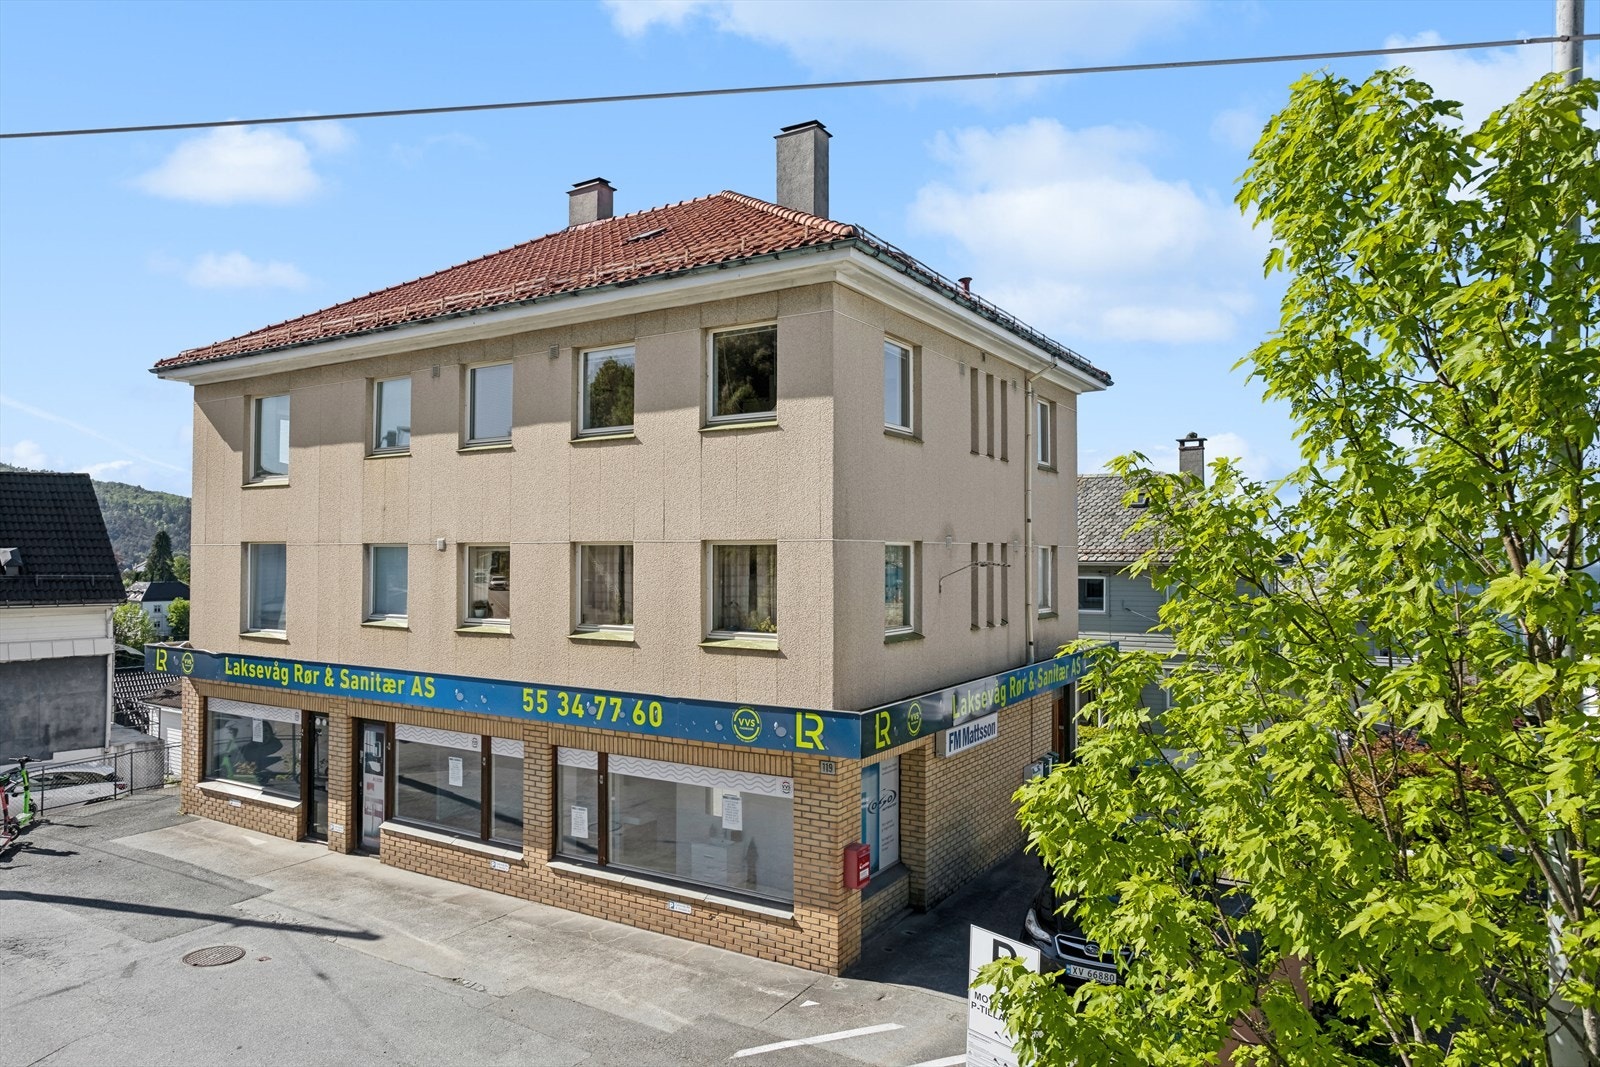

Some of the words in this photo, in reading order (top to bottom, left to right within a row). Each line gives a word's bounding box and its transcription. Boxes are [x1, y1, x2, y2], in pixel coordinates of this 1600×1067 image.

[156, 649, 167, 671] LR
[225, 657, 289, 685] Laksevåg
[294, 663, 320, 685] Rør
[324, 667, 334, 687] &
[340, 668, 405, 694] Sanitær
[410, 676, 435, 698] AS
[952, 680, 1006, 719] Laksevåg
[1009, 676, 1026, 698] Rør
[1029, 671, 1035, 691] &
[1038, 663, 1069, 688] Sanitær
[1071, 656, 1081, 676] AS
[523, 687, 547, 713] 55
[558, 691, 584, 717] 34
[594, 695, 622, 721] 77
[632, 701, 663, 728] 60
[738, 718, 756, 727] VVS
[795, 712, 825, 750] LR
[876, 711, 891, 749] LR
[949, 729, 961, 752] FM
[962, 722, 996, 747] Mattsson
[822, 763, 833, 773] 119
[1072, 966, 1084, 976] XV
[1087, 970, 1115, 982] 66880
[974, 991, 990, 1003] MO
[971, 1001, 1009, 1023] P-TILLA
